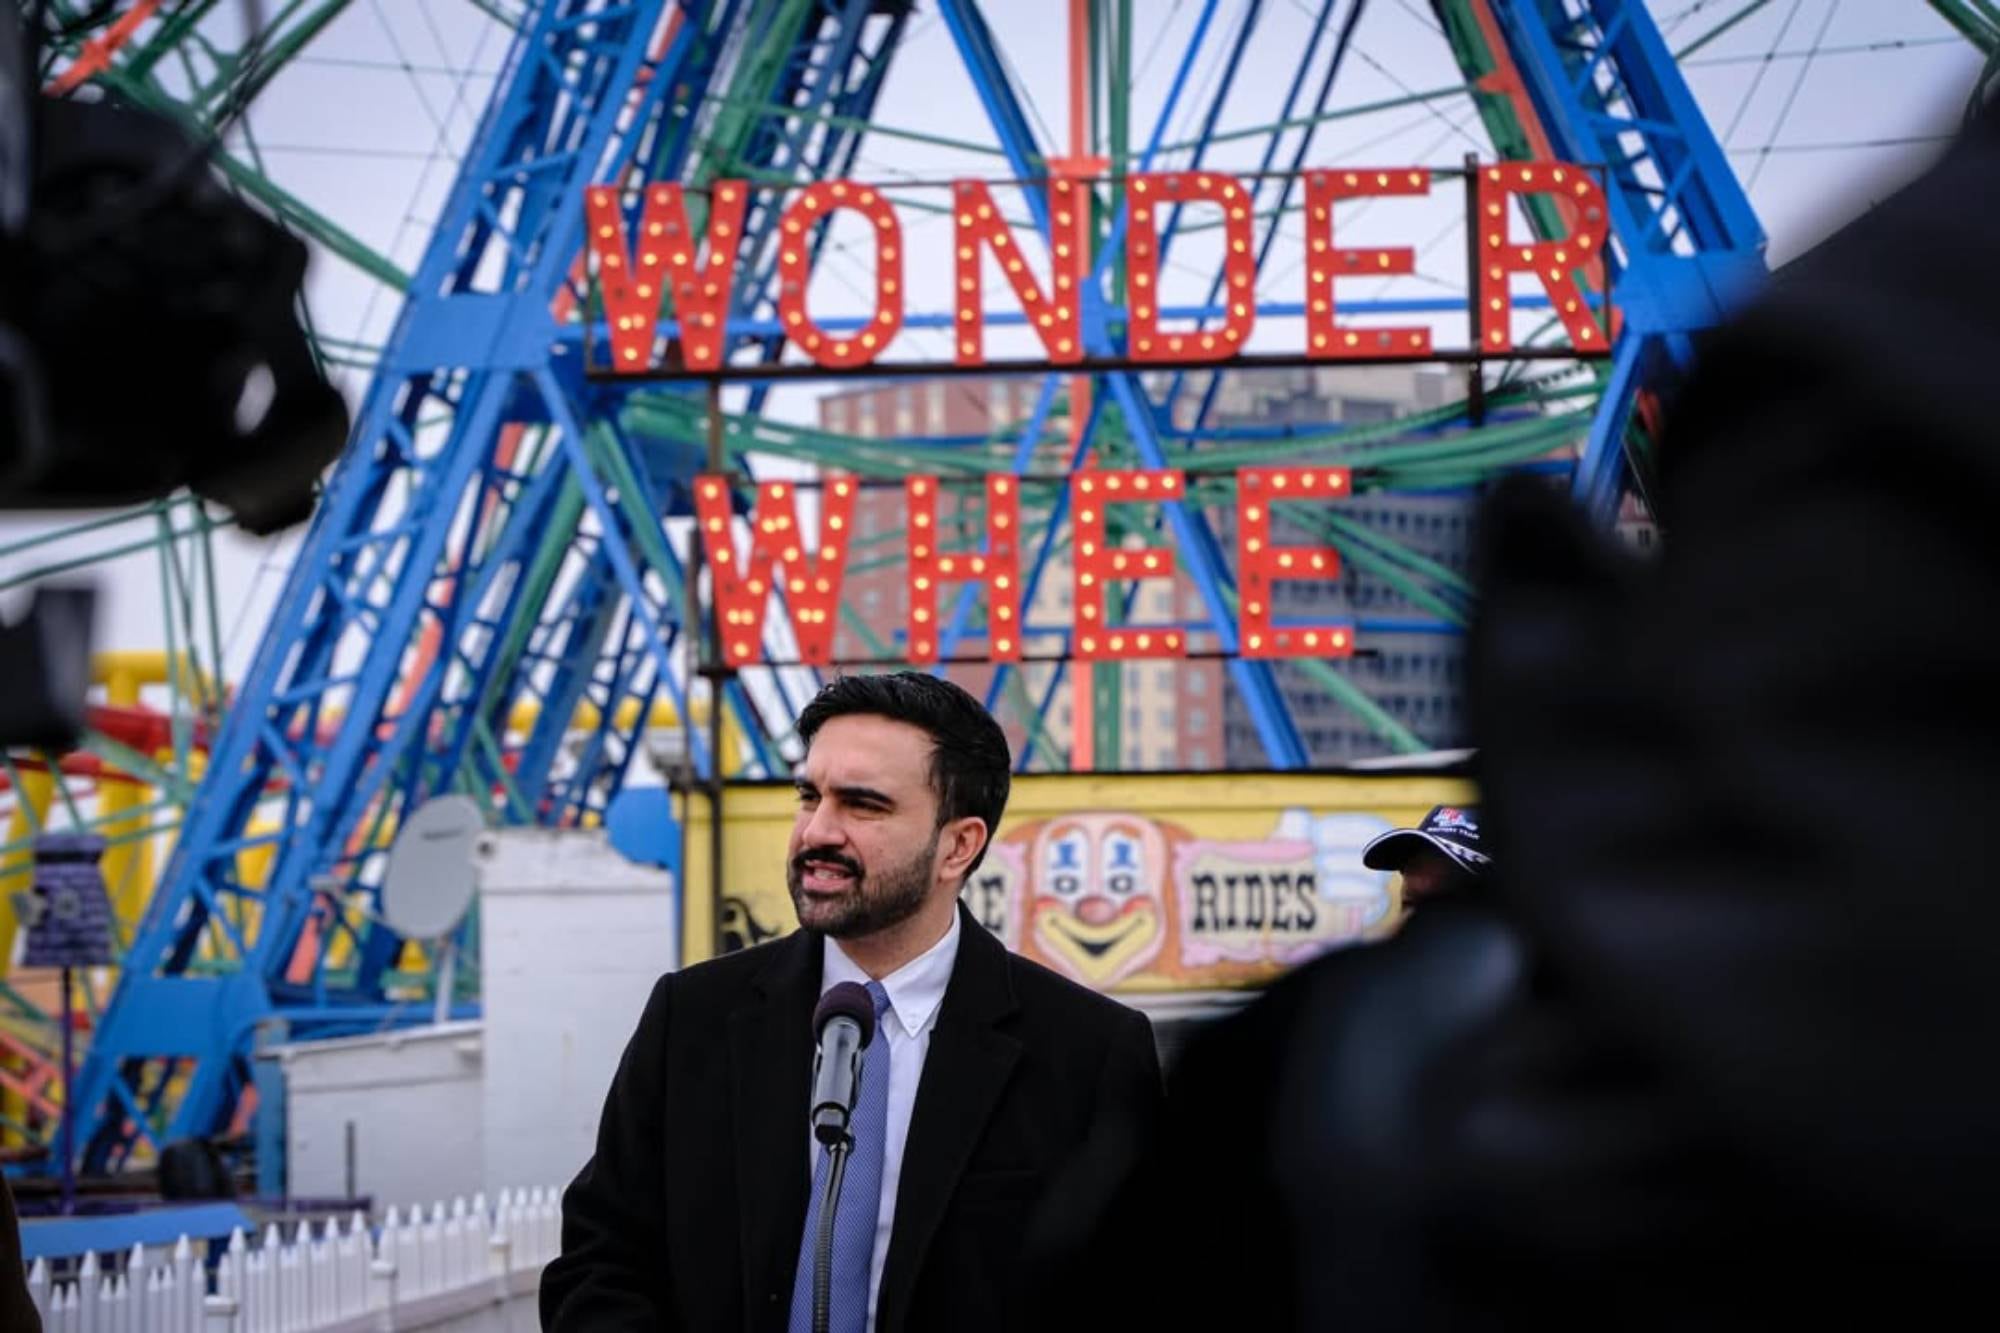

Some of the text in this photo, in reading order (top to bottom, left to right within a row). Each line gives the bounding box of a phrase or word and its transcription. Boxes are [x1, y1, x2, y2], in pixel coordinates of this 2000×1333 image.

[585, 162, 1611, 371] WONDER
[694, 468, 1354, 664] WHEE
[1192, 874, 1318, 931] RIDES
